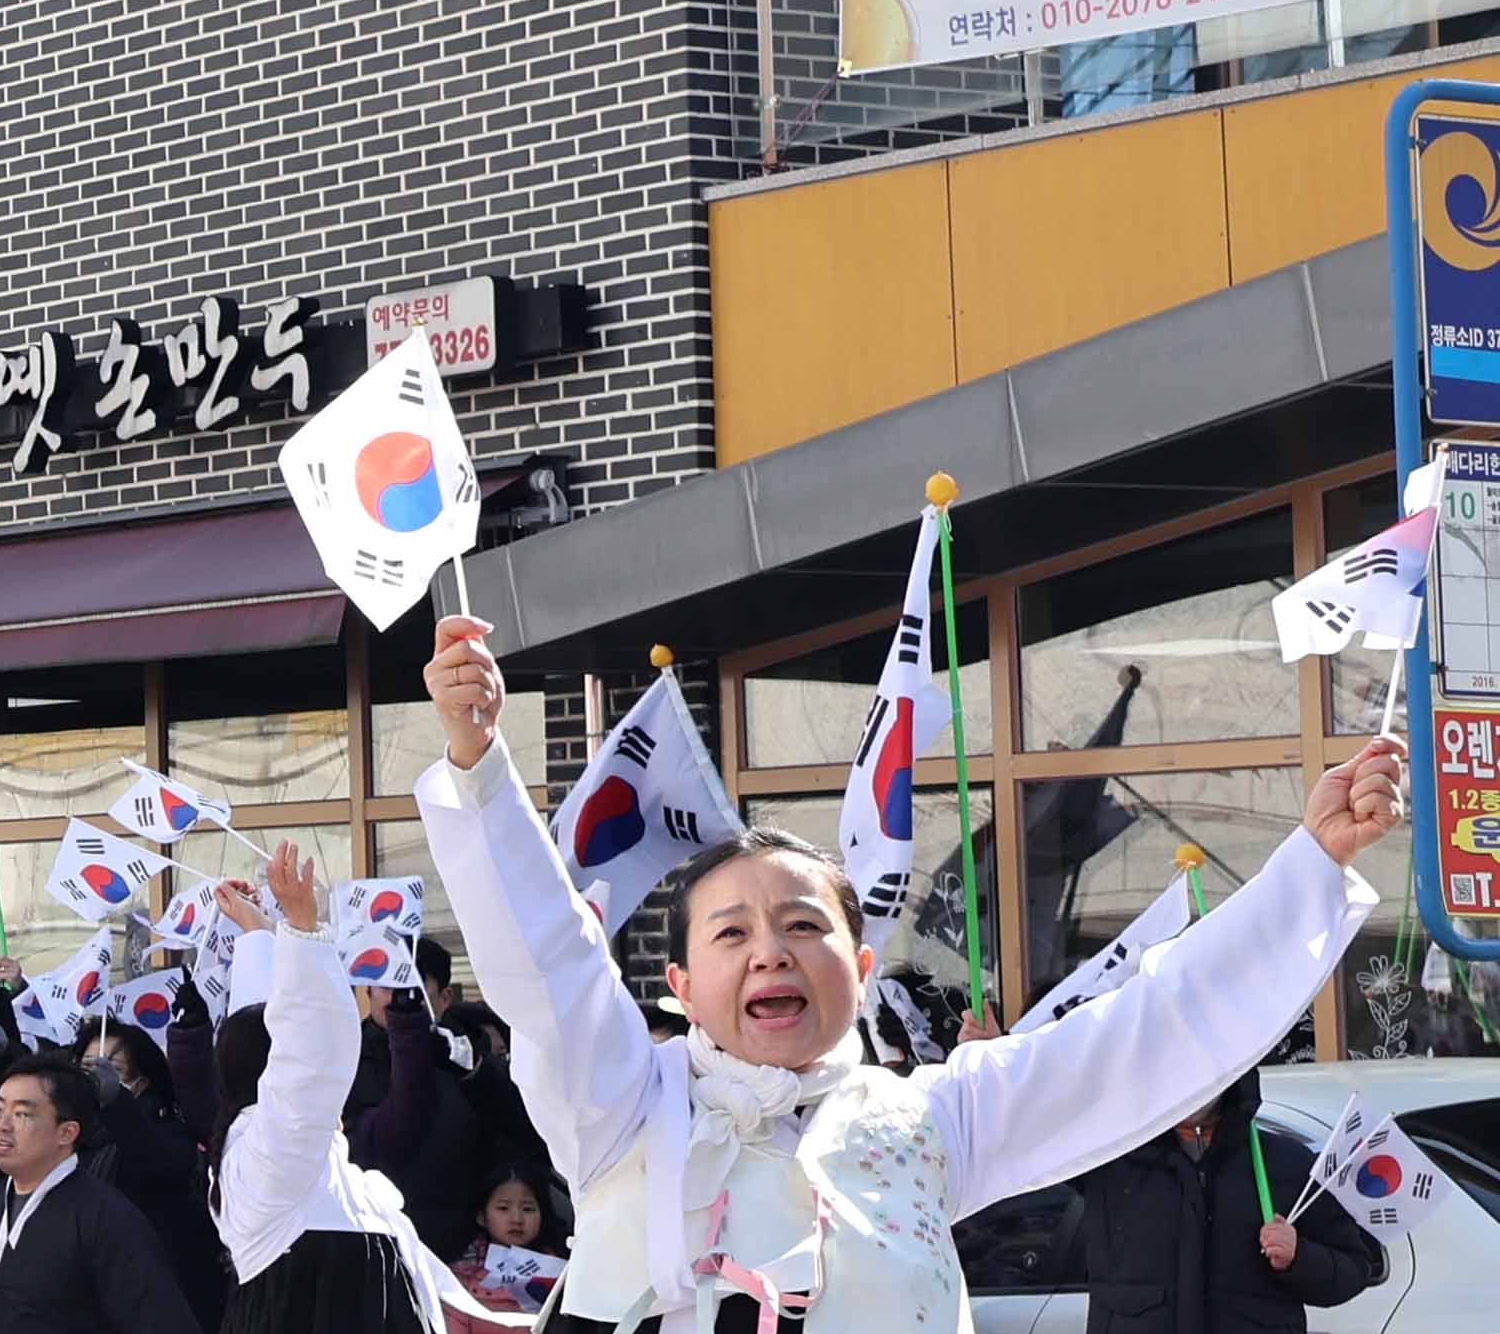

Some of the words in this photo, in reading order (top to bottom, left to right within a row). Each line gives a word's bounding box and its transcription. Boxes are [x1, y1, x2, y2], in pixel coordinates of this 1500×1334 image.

[948, 5, 1017, 47] 연락처
[372, 294, 449, 331] 예약문의
[1430, 323, 1484, 347] 정류소ID
[95, 296, 309, 441] 손만두
[1445, 491, 1475, 520] 10
[1442, 720, 1500, 779] 오렌
